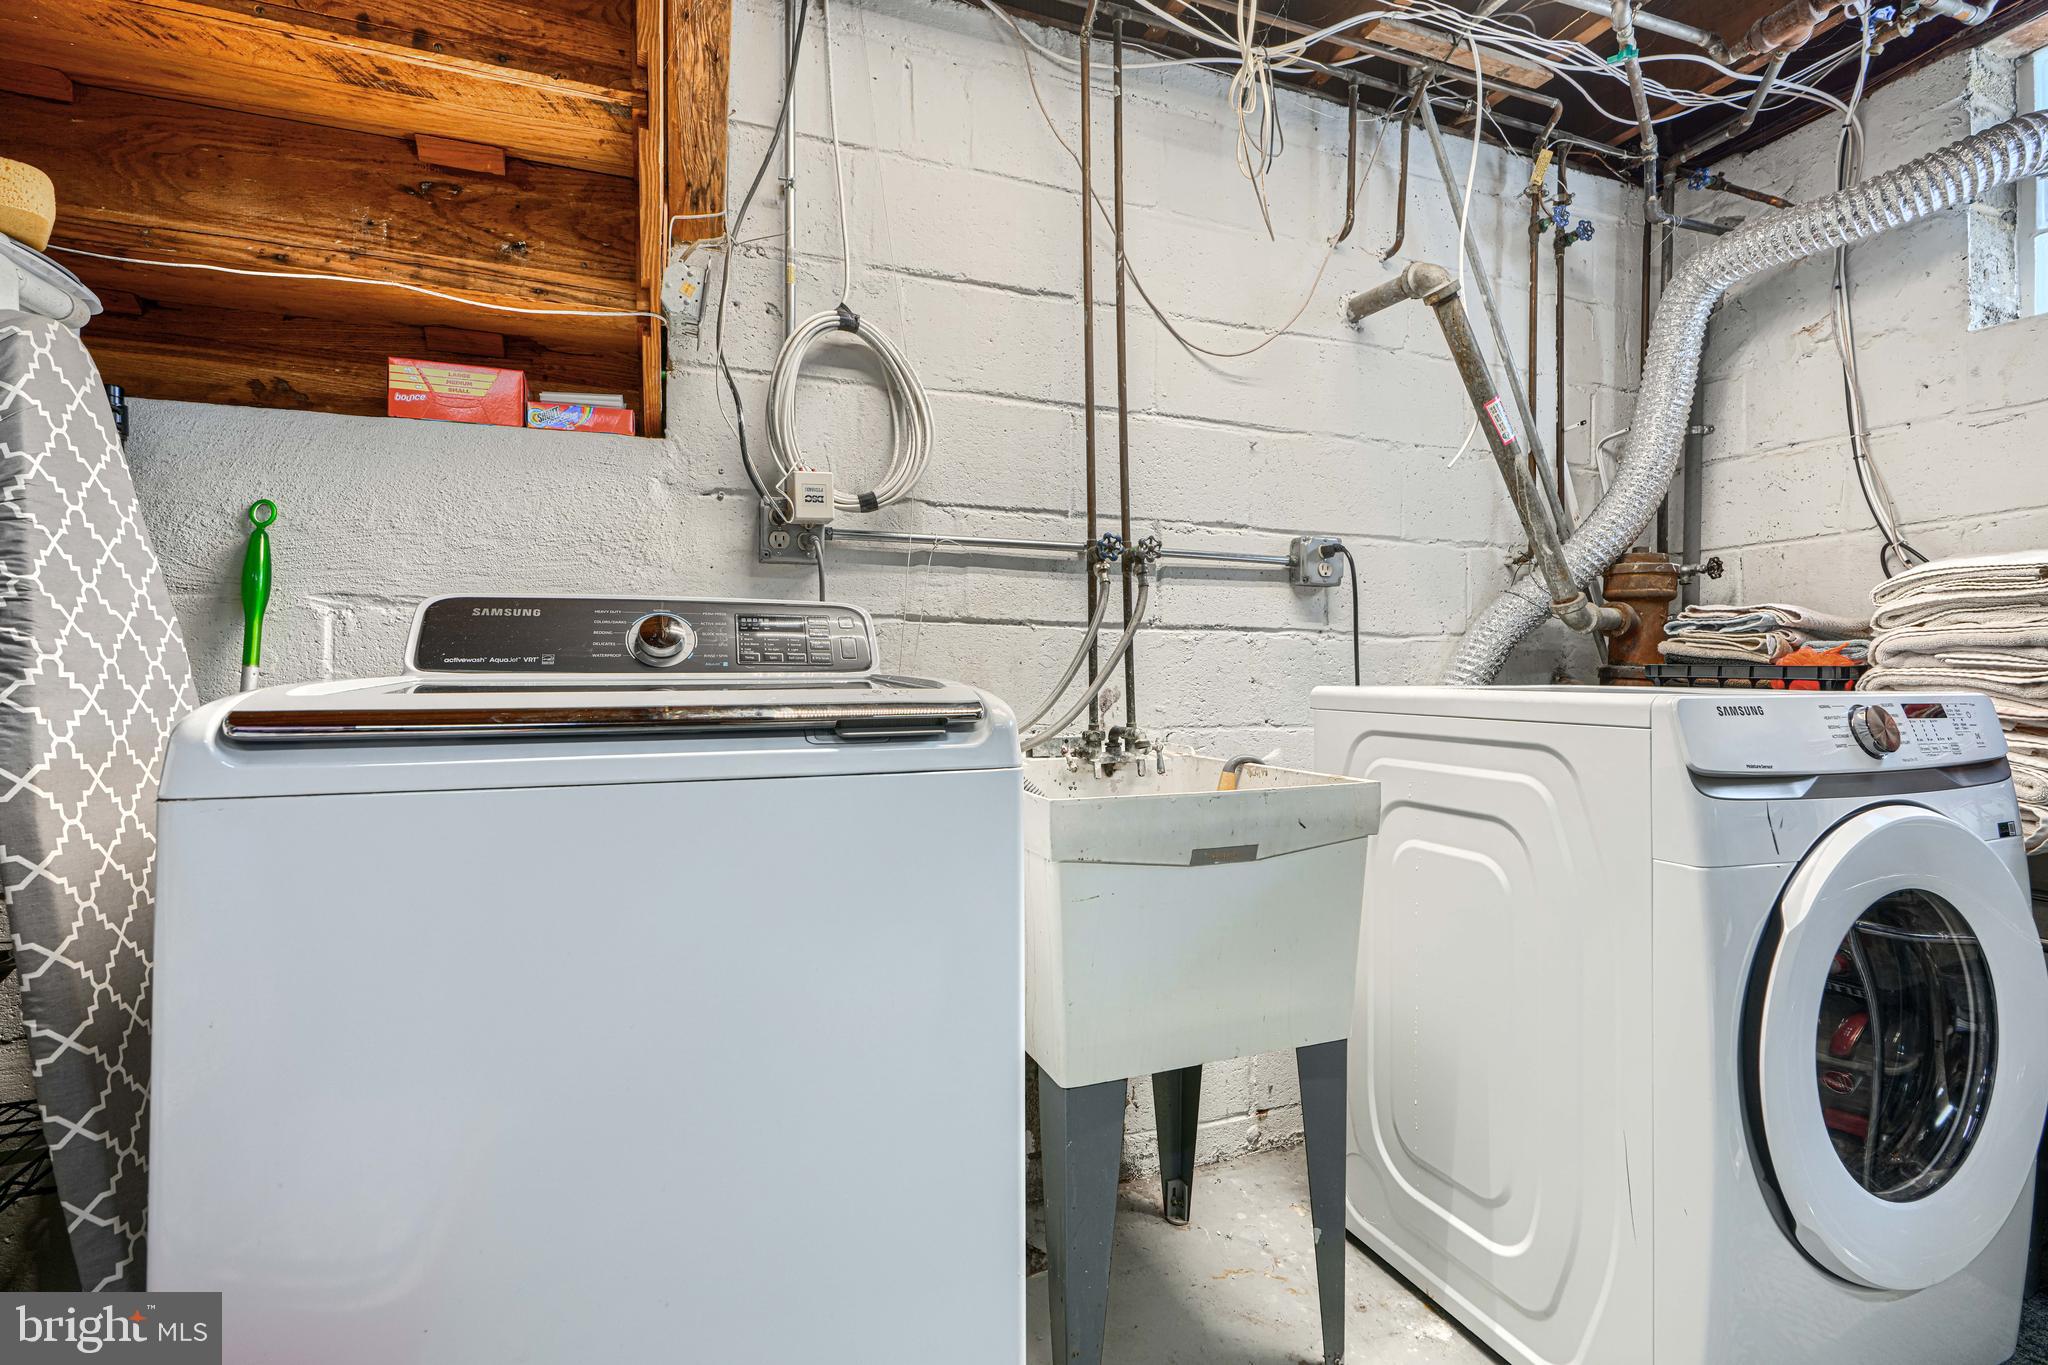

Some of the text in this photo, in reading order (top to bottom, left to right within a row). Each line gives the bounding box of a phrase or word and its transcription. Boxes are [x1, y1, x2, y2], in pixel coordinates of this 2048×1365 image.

[394, 392, 427, 402] bounce
[472, 607, 541, 617] SAMSUNG
[1716, 705, 1765, 717] SAMSUNG
